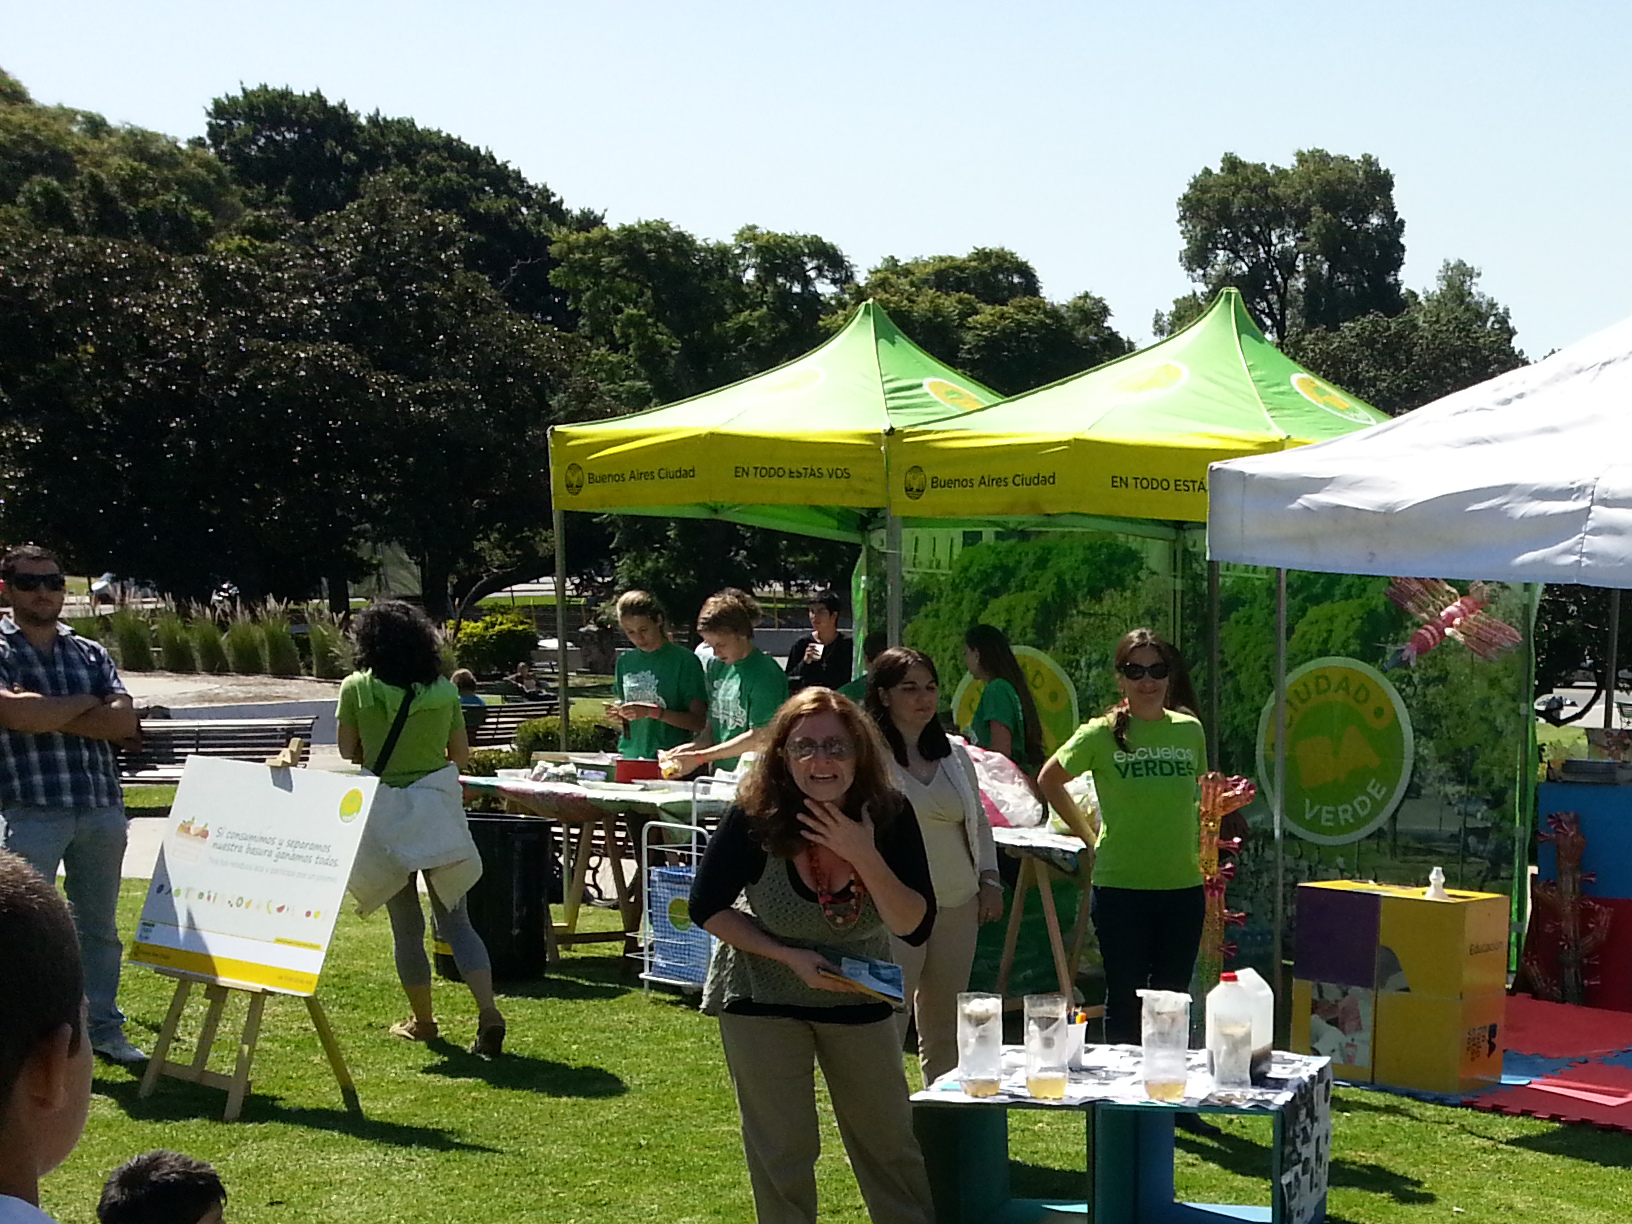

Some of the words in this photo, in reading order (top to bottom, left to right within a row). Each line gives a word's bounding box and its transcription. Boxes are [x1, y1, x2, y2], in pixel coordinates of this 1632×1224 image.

[587, 471, 626, 485] Buenos
[628, 468, 655, 481] Aires
[656, 465, 696, 479] Ciudad
[734, 465, 750, 478] EN
[752, 465, 786, 478] TODO
[826, 466, 851, 479] VOS
[930, 475, 974, 489] Buenos
[977, 474, 1009, 487] Aires
[1011, 472, 1056, 487] Ciudad
[1110, 475, 1129, 488] EN
[1133, 477, 1170, 491] TODO
[1174, 476, 1208, 494] ESTÁ
[1113, 745, 1194, 762] escuelas
[1113, 760, 1195, 779] VERDES
[1304, 777, 1387, 827] VERDE
[211, 841, 244, 854] nuestra
[245, 843, 273, 858] basura
[225, 829, 276, 846] consumimos
[285, 838, 332, 854] separamos
